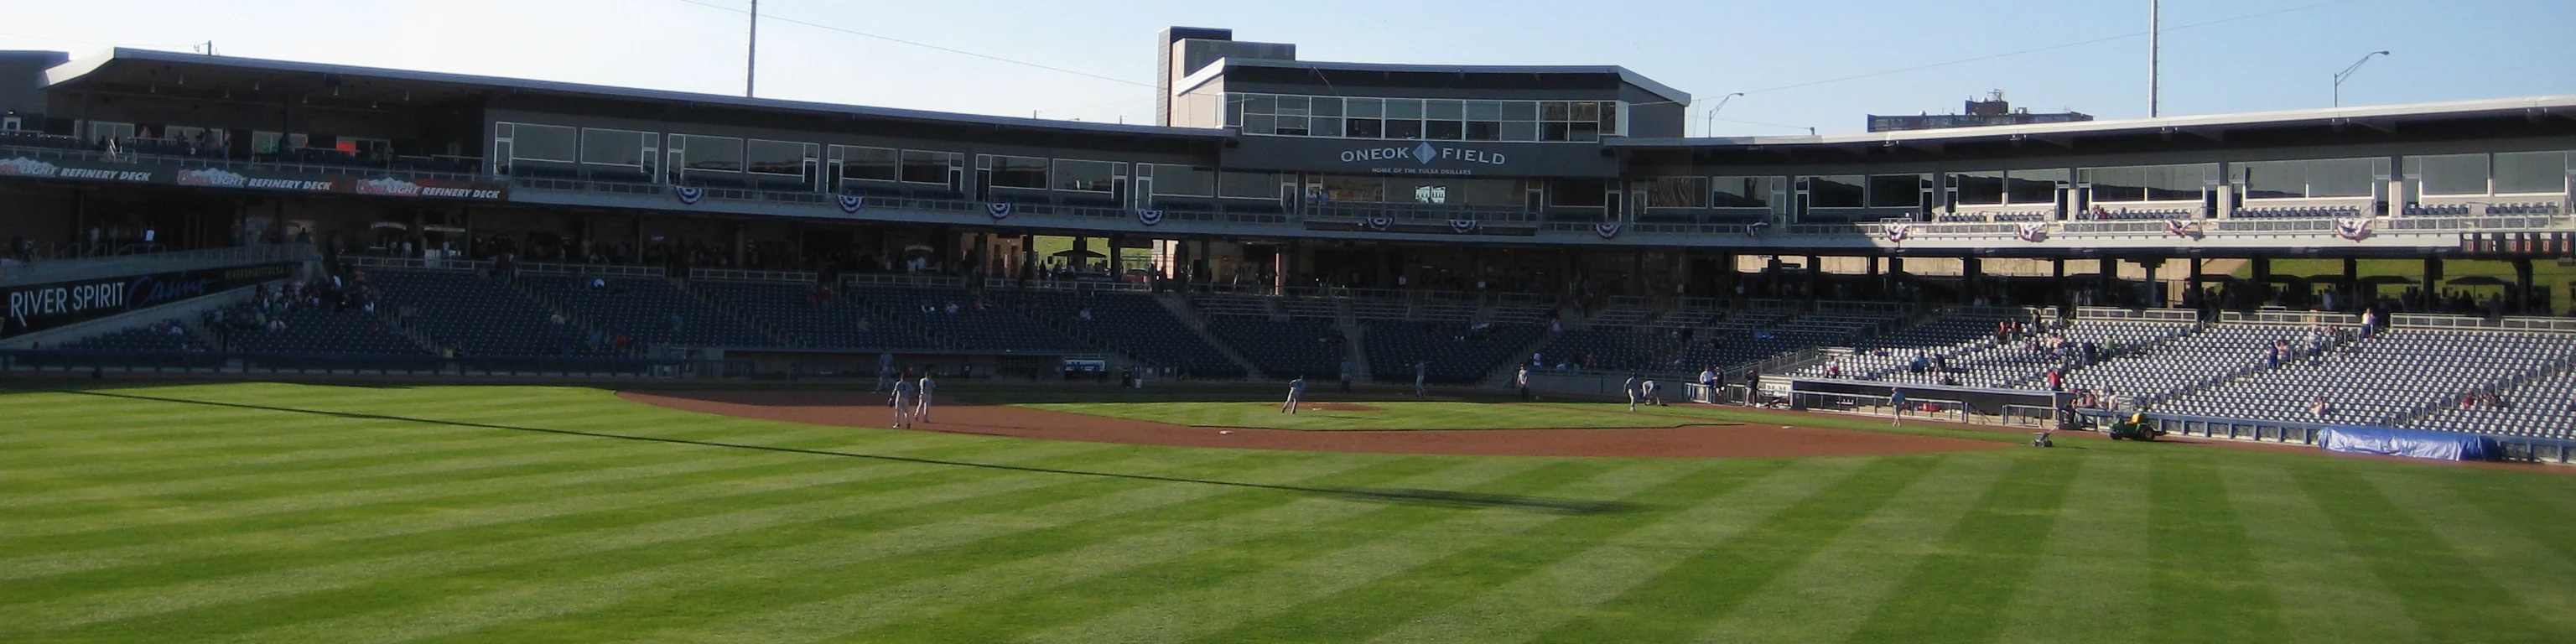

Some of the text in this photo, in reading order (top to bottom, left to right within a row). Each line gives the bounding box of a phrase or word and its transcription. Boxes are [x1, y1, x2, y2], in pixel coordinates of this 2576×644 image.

[1341, 147, 1506, 165] ONEOK FIELD
[60, 167, 117, 179] REFINERY
[119, 171, 152, 181] DECK
[210, 174, 247, 186] LIGHT
[248, 178, 301, 190] REFINERY
[303, 181, 333, 190] DECK
[387, 185, 421, 194] LIGHT
[422, 186, 472, 197] REFINERY
[473, 190, 501, 199] DECK
[10, 287, 67, 327] RIVER
[72, 282, 125, 311] SPIRIT
